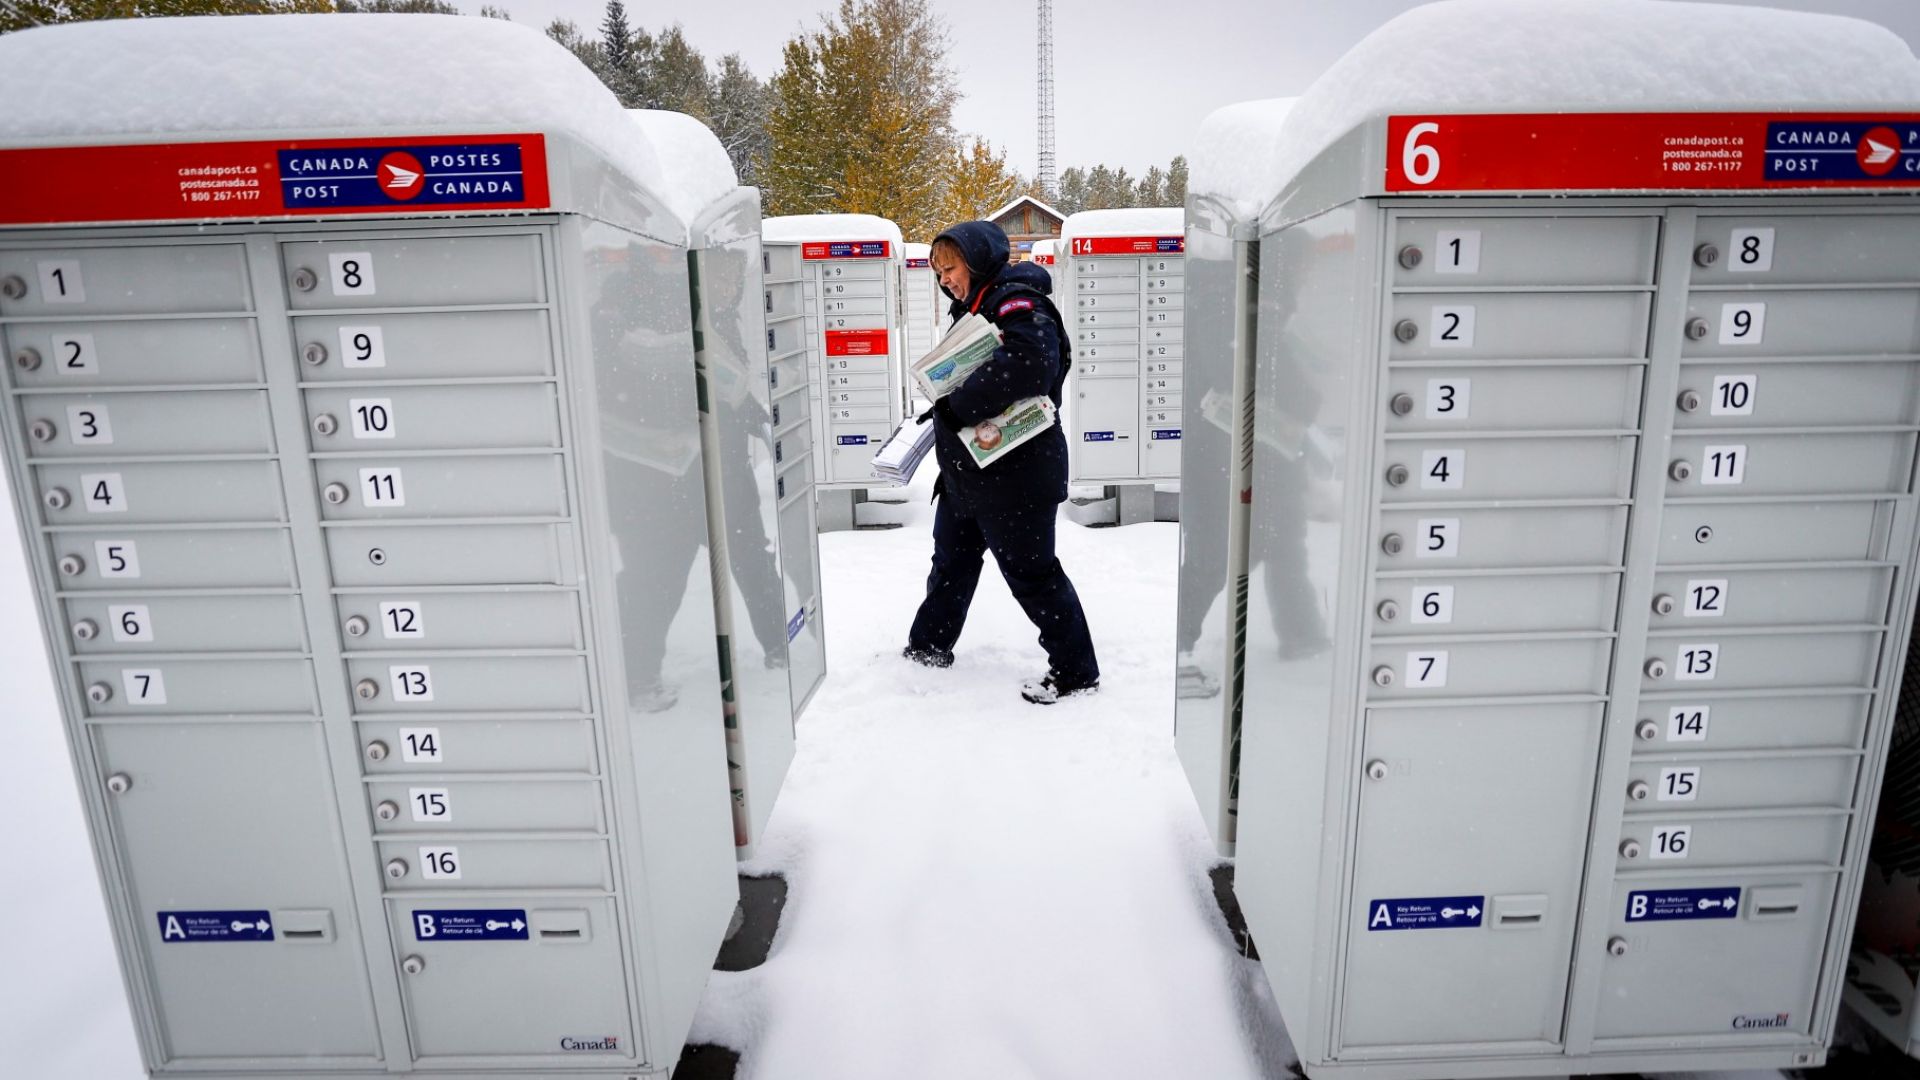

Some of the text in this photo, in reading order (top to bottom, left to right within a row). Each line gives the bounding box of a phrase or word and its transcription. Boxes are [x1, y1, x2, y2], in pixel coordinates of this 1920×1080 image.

[1664, 136, 1744, 147] canadapost.ca
[1777, 131, 1851, 144] CANADA
[430, 153, 501, 168] POSTES
[1402, 122, 1440, 185] 6
[1663, 149, 1743, 160] postescanada.ca
[178, 165, 257, 177] canadapost.ca
[290, 157, 369, 173] CANADA
[1663, 161, 1742, 171] 1 800 267-1177
[1774, 159, 1819, 171] POST
[180, 177, 259, 190] postescanada.ca
[433, 181, 513, 196] CANADA
[182, 190, 260, 202] 1 800 267-1177
[293, 186, 339, 200] POST
[1074, 239, 1092, 253] 14
[1449, 238, 1461, 266] 1
[1740, 235, 1761, 264] 8
[1038, 256, 1048, 264] 22
[1090, 263, 1095, 272] 1
[1159, 262, 1165, 271] 8
[342, 260, 362, 289] 8
[835, 267, 842, 276] 9
[51, 268, 66, 296] 1
[835, 284, 844, 293] 10
[1089, 280, 1096, 289] 2
[1159, 279, 1166, 288] 9
[836, 301, 844, 310] 11
[1090, 297, 1096, 306] 3
[1157, 296, 1167, 304] 10
[836, 318, 845, 327] 12
[1158, 313, 1166, 321] 11
[1733, 310, 1752, 338] 9
[1441, 312, 1460, 341] 2
[1090, 331, 1096, 340] 5
[64, 340, 85, 368] 2
[353, 333, 372, 361] 9
[1090, 348, 1097, 357] 6
[1158, 346, 1166, 355] 12
[839, 360, 848, 369] 13
[1090, 364, 1096, 373] 7
[1158, 363, 1167, 372] 13
[839, 377, 848, 385] 14
[1157, 380, 1166, 388] 14
[840, 393, 849, 402] 15
[1157, 396, 1166, 405] 15
[1437, 385, 1455, 413] 3
[1719, 381, 1749, 409] 10
[357, 405, 388, 432] 10
[840, 410, 850, 418] 16
[1157, 412, 1166, 421] 16
[79, 411, 98, 438] 3
[1152, 431, 1158, 439] B
[1430, 456, 1450, 482] 4
[1711, 451, 1736, 478] 11
[93, 480, 112, 505] 4
[368, 474, 395, 500] 11
[1428, 525, 1445, 551] 5
[108, 546, 126, 572] 5
[1422, 592, 1440, 617] 6
[1693, 585, 1720, 611] 12
[121, 611, 140, 636] 6
[387, 608, 417, 633] 12
[1418, 657, 1435, 681] 7
[1684, 649, 1713, 674] 13
[134, 675, 150, 698] 7
[398, 671, 428, 696] 13
[1675, 711, 1703, 735] 14
[406, 733, 438, 757] 14
[1666, 772, 1695, 795] 15
[416, 793, 446, 816] 15
[1657, 831, 1686, 853] 16
[426, 852, 456, 874] 16
[1630, 895, 1648, 918] B
[1371, 904, 1392, 927] A
[165, 915, 186, 939] A
[417, 914, 436, 937] B
[1732, 1013, 1788, 1029] Canada
[560, 1036, 617, 1051] Canada
